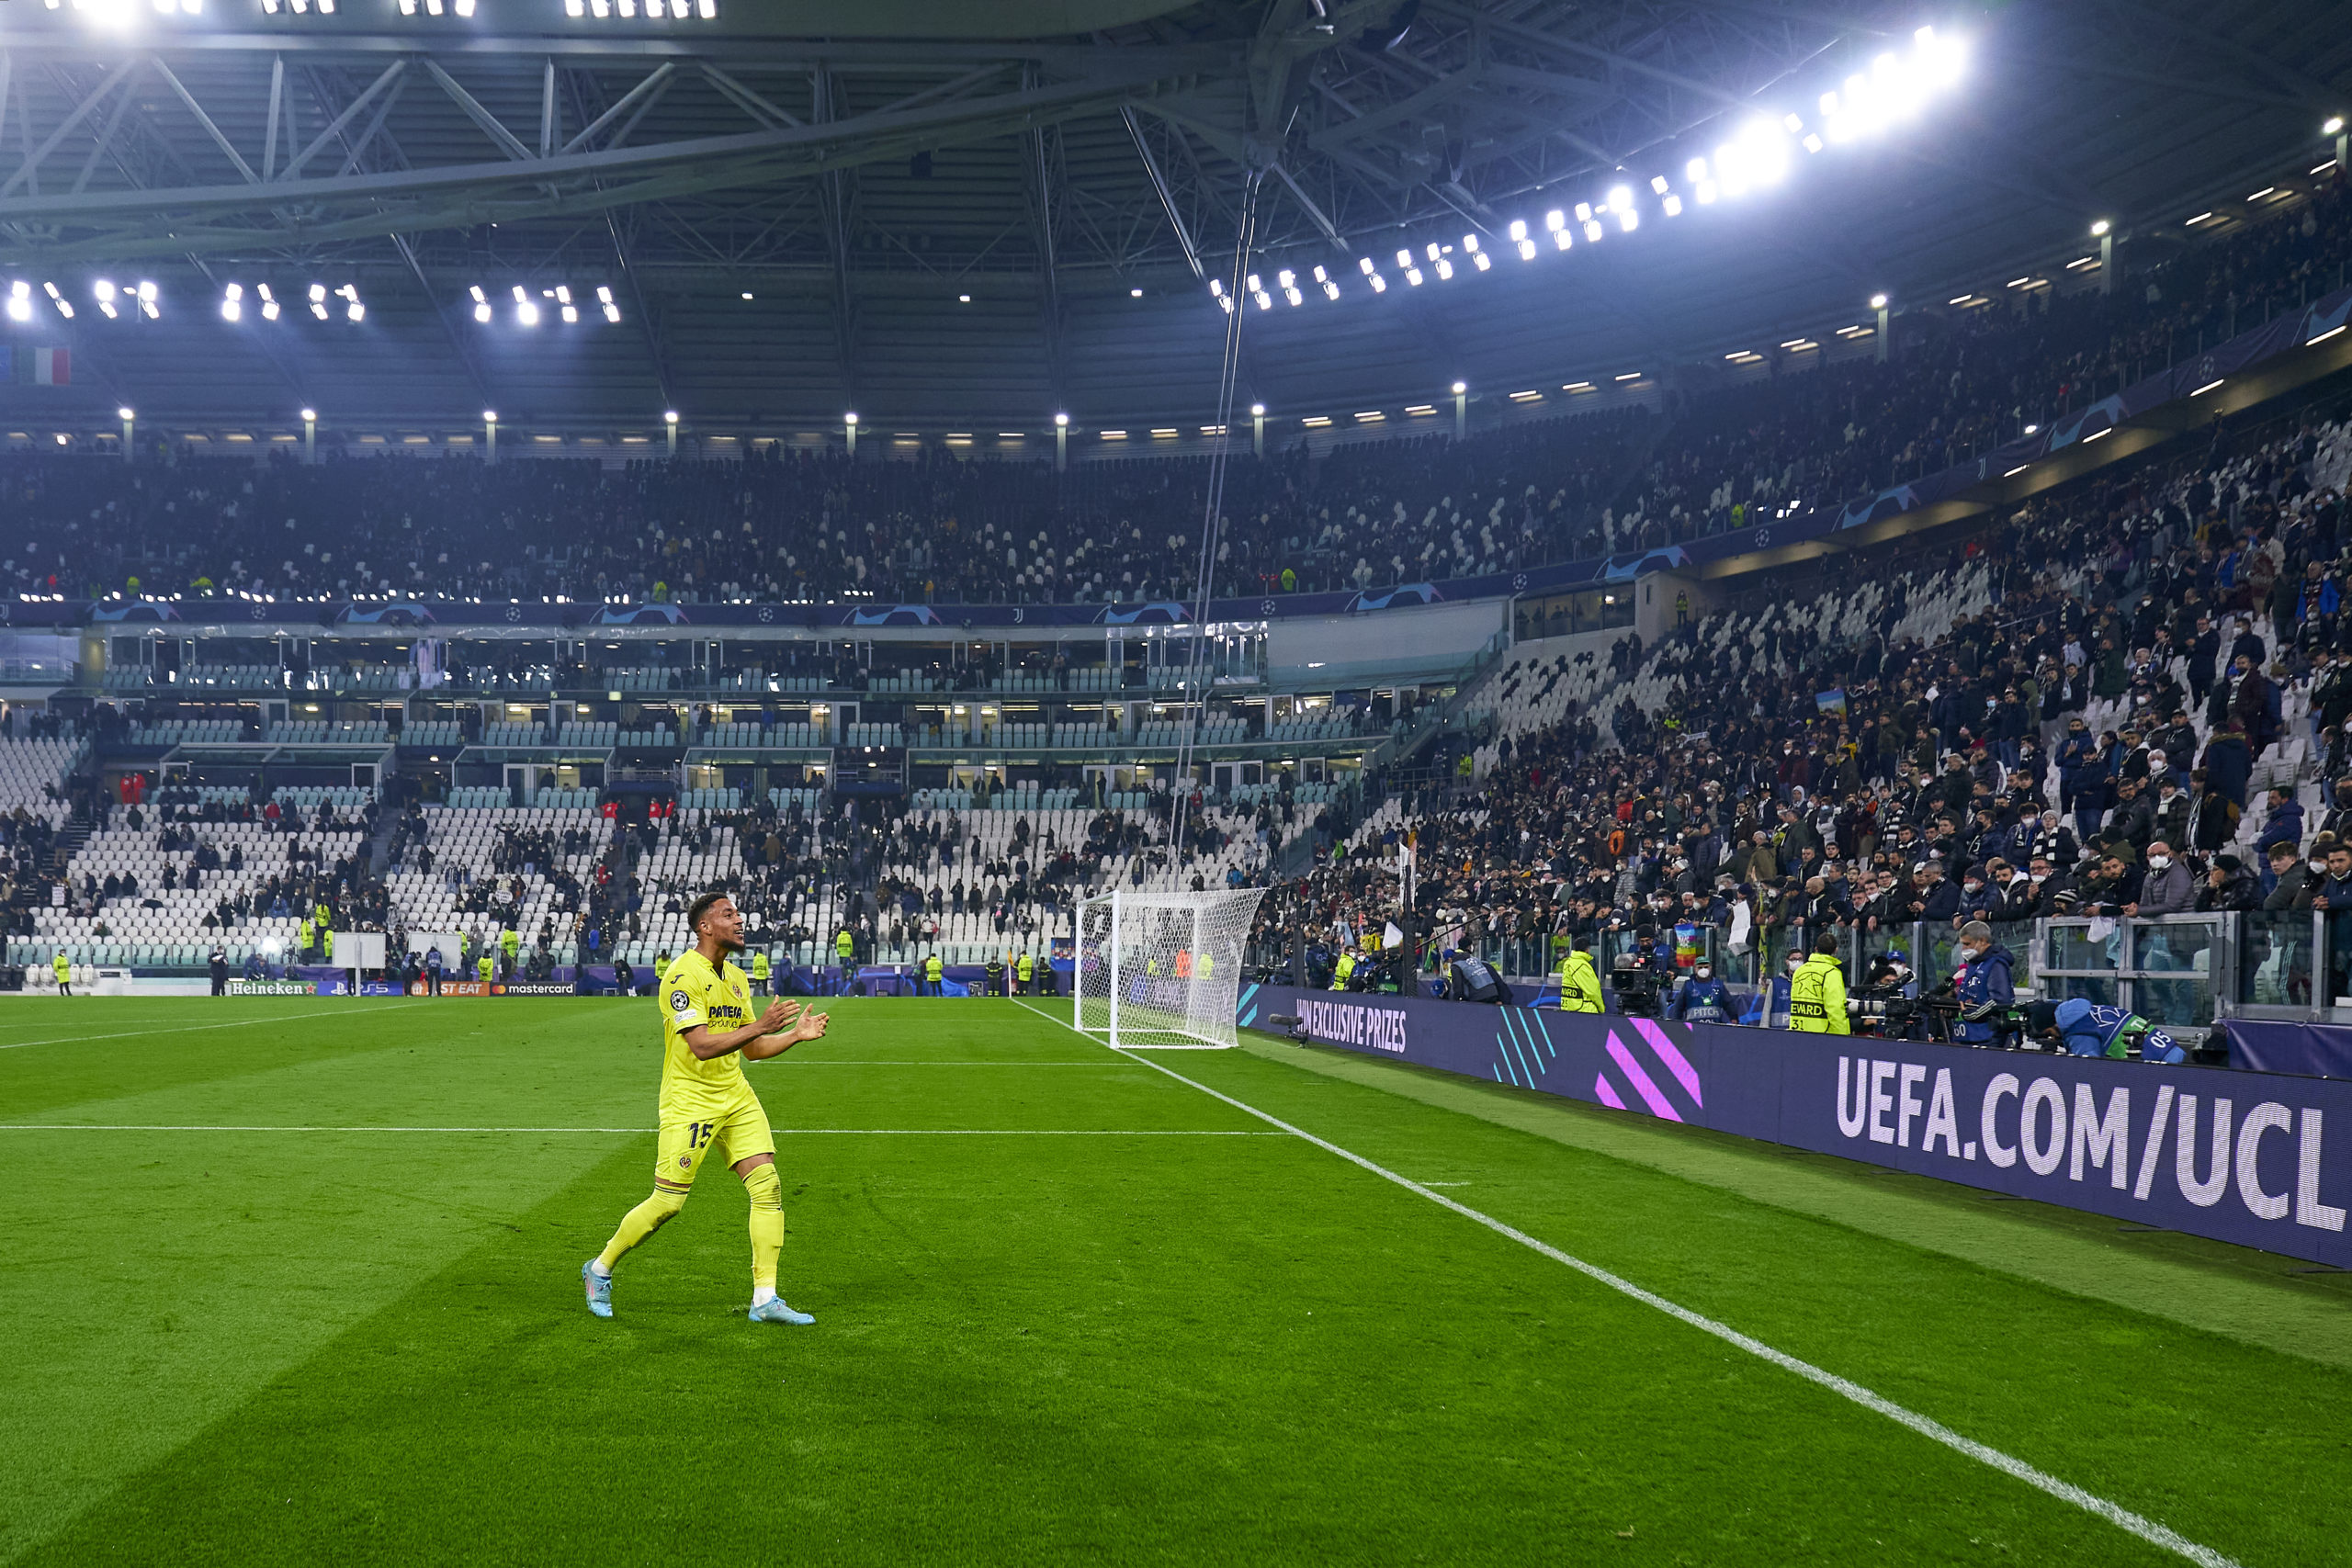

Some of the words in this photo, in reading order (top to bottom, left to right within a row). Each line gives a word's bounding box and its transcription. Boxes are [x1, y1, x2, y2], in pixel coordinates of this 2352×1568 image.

[232, 982, 303, 995] Heineken
[458, 983, 482, 994] EAT
[508, 983, 573, 994] mastercard
[1693, 1007, 1719, 1017] PITCH
[1296, 998, 1312, 1034] WIN
[1312, 1000, 1364, 1045] EXCLUSIVE
[1366, 1007, 1407, 1054] PRIZES
[1791, 1019, 1804, 1031] 31
[2150, 1031, 2172, 1049] 05
[688, 1122, 714, 1149] 15
[1837, 1055, 2347, 1233] UEFA.COM/UCL
